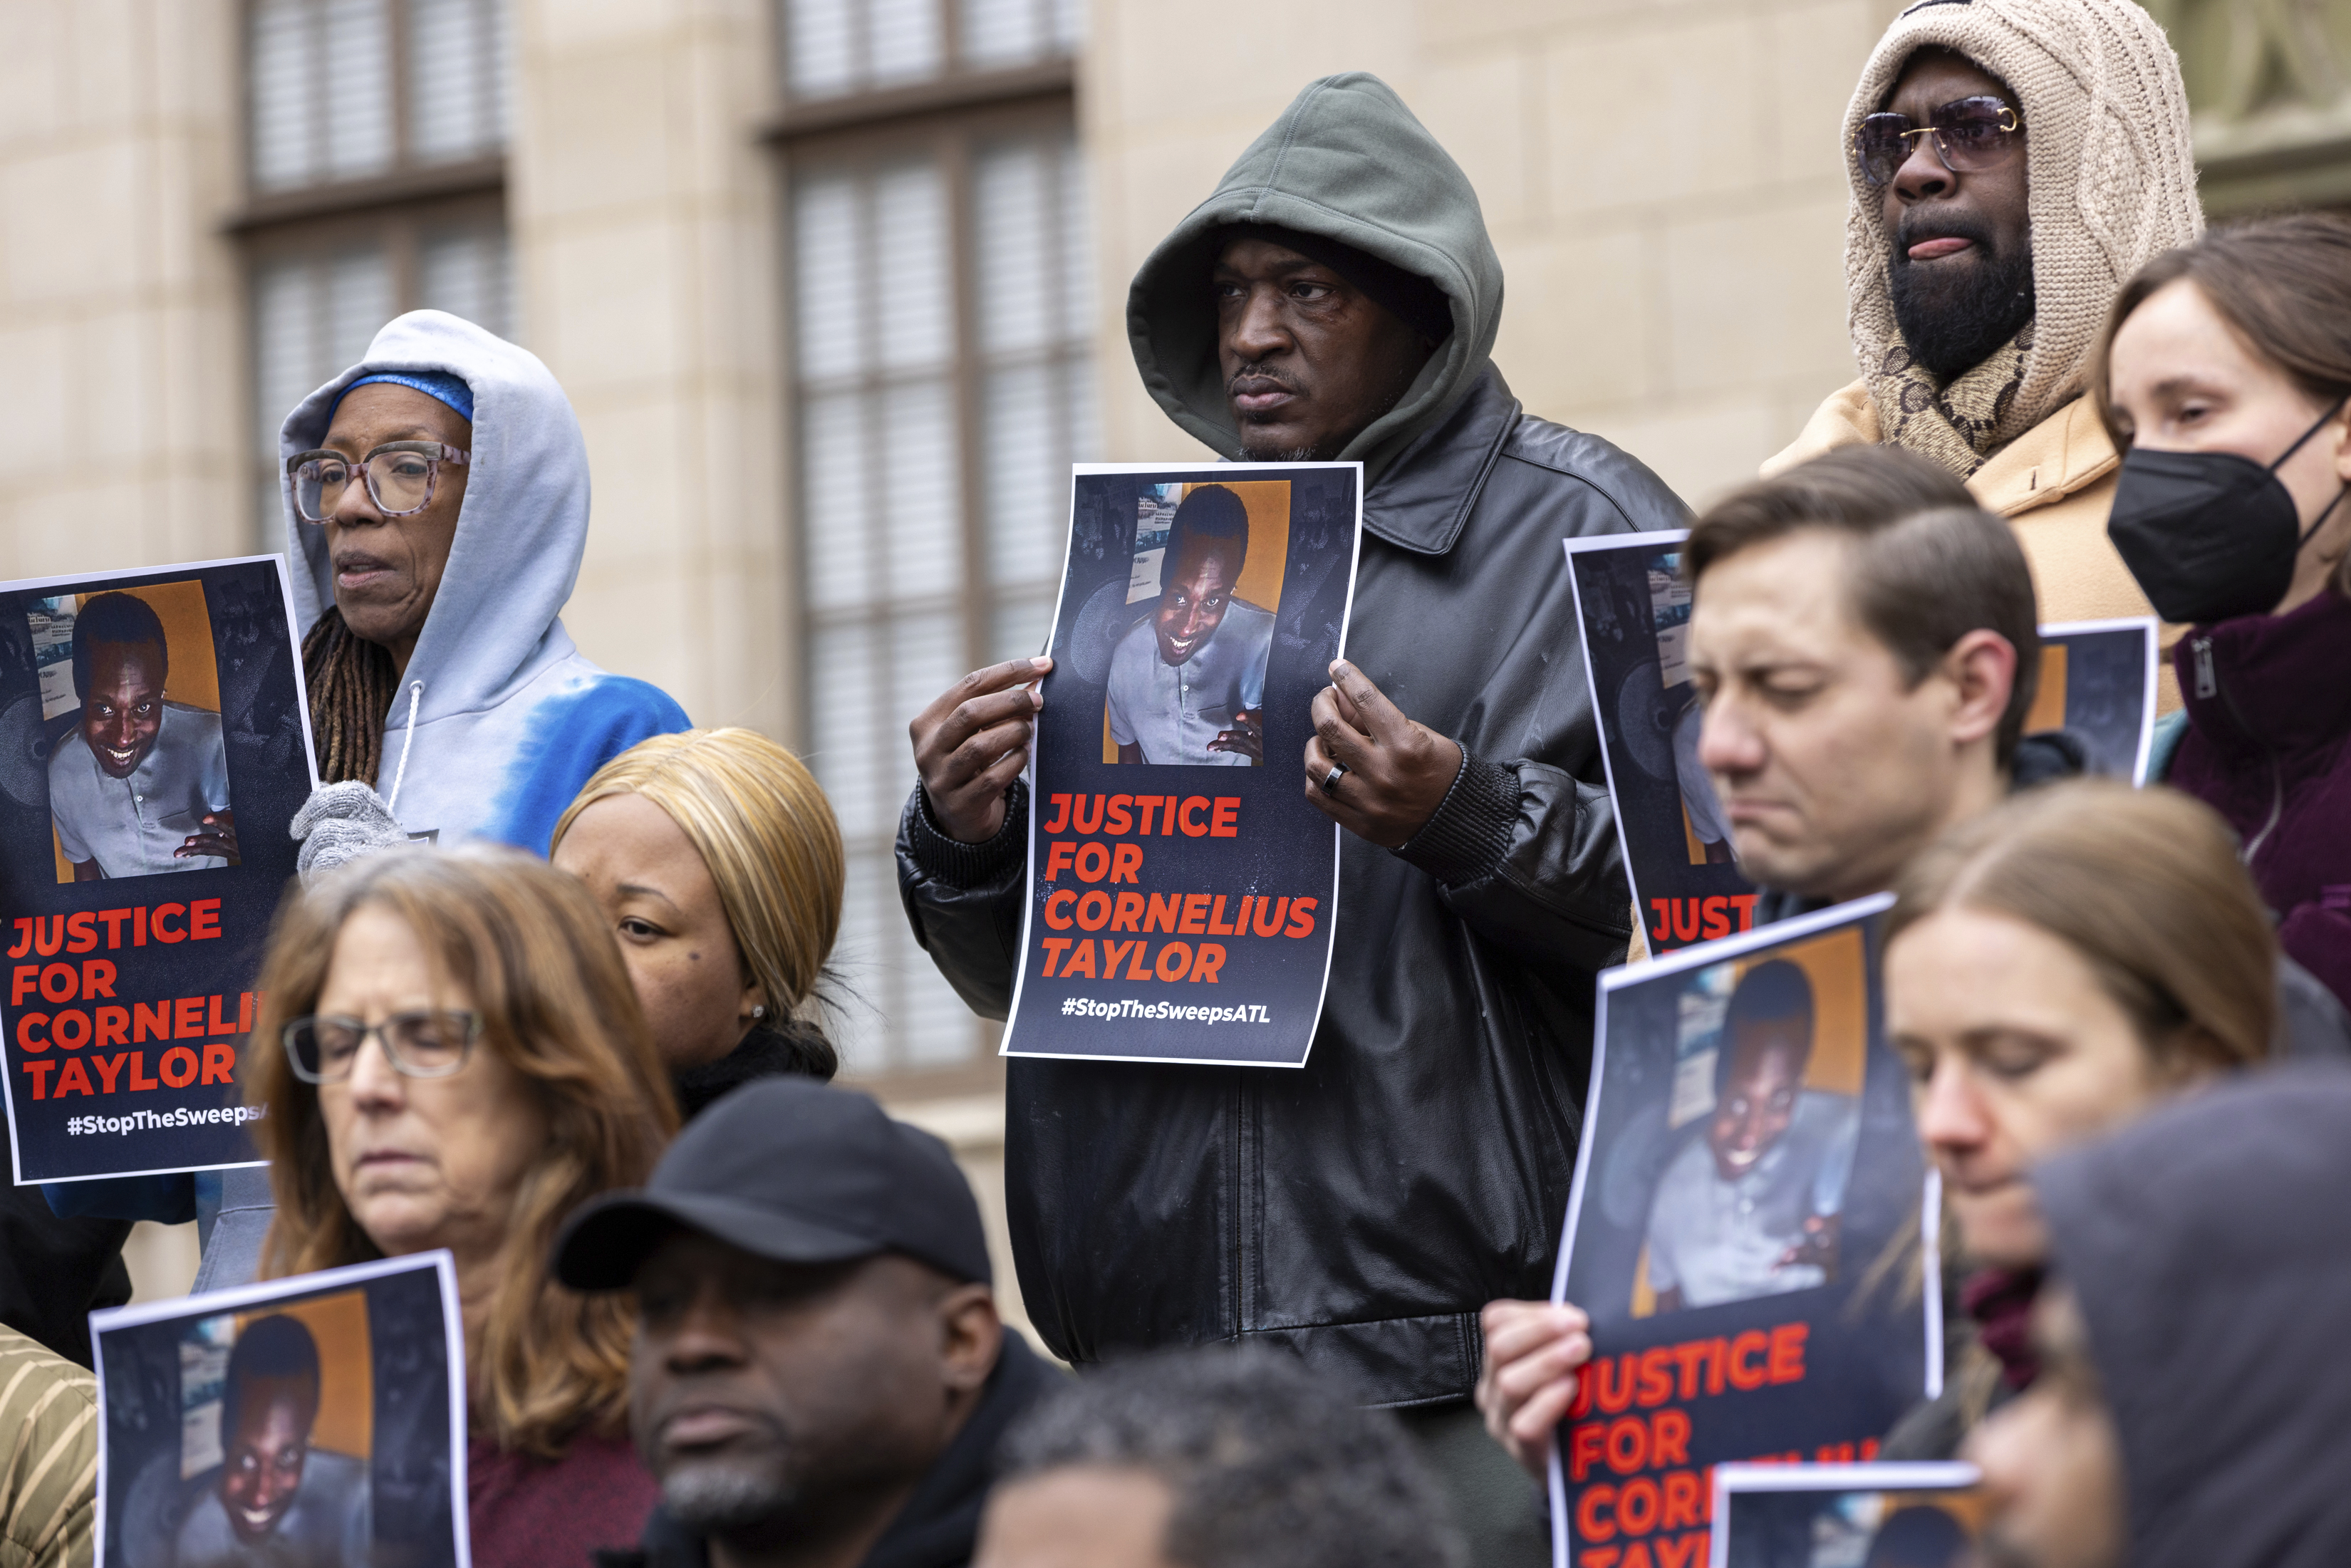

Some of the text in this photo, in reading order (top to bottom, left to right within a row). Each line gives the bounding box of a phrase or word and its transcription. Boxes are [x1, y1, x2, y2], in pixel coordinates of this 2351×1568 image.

[1043, 793, 1241, 838] JUSTICE
[1044, 841, 1143, 884] FOR
[6, 898, 222, 959] JUSTICE
[1044, 888, 1319, 939] CORNELIUS
[11, 959, 118, 1007] FOR
[1041, 937, 1227, 984] TAYLOR
[16, 991, 268, 1054] CORNELI
[1061, 997, 1271, 1026] #StopTheSweepsATL
[23, 1043, 236, 1101] TAYLOR
[1572, 1322, 1810, 1418] JUSTICE
[1571, 1408, 1692, 1483] FOR
